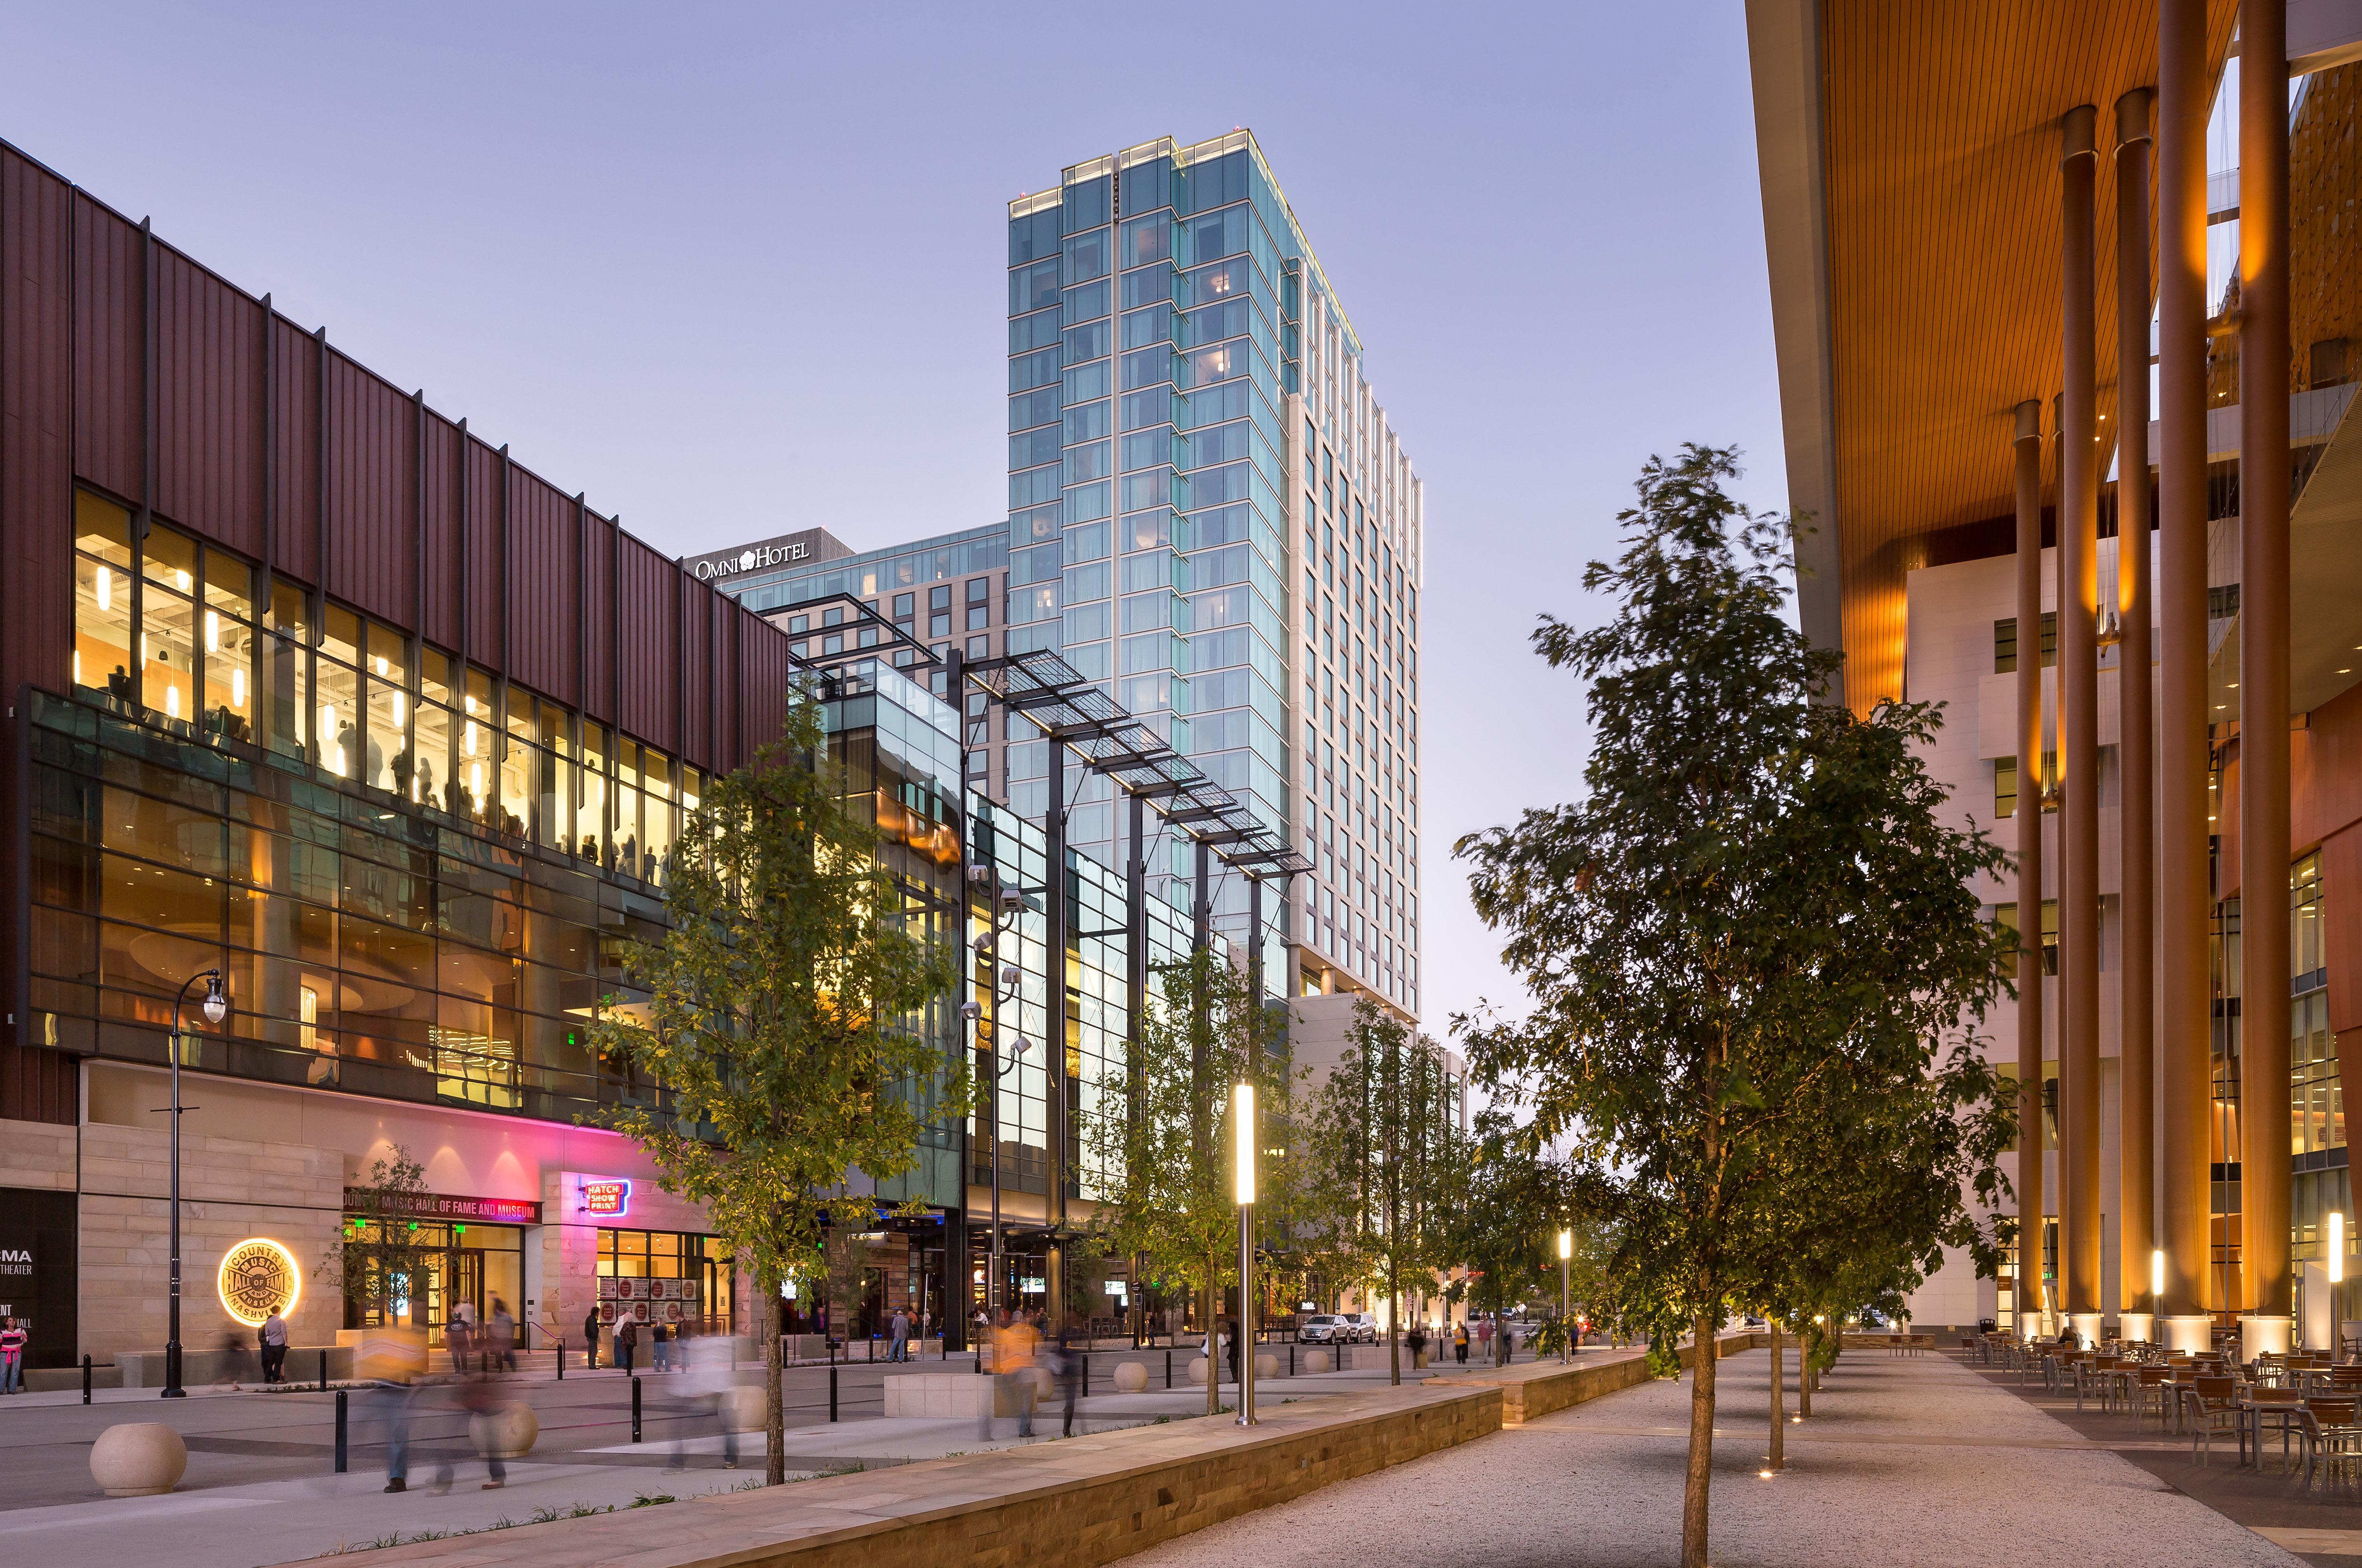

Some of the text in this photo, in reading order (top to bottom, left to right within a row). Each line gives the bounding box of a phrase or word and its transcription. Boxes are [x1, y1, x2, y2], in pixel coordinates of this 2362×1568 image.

[695, 542, 810, 580] OMNI HOTEL
[588, 1185, 620, 1194] HATCH
[416, 1198, 437, 1212] HALL
[439, 1200, 451, 1213] OF
[452, 1201, 477, 1215] FAME
[478, 1203, 496, 1216] AND
[497, 1204, 535, 1218] MUSEUM
[0, 1250, 32, 1262] MA
[232, 1247, 287, 1268] COUNTRY
[0, 1264, 32, 1275] THEATER
[241, 1258, 277, 1273] MUSIC
[224, 1268, 250, 1295] HALL
[240, 1292, 277, 1306] MUSEUM
[0, 1304, 12, 1316] NT
[231, 1298, 286, 1318] NASHVIE
